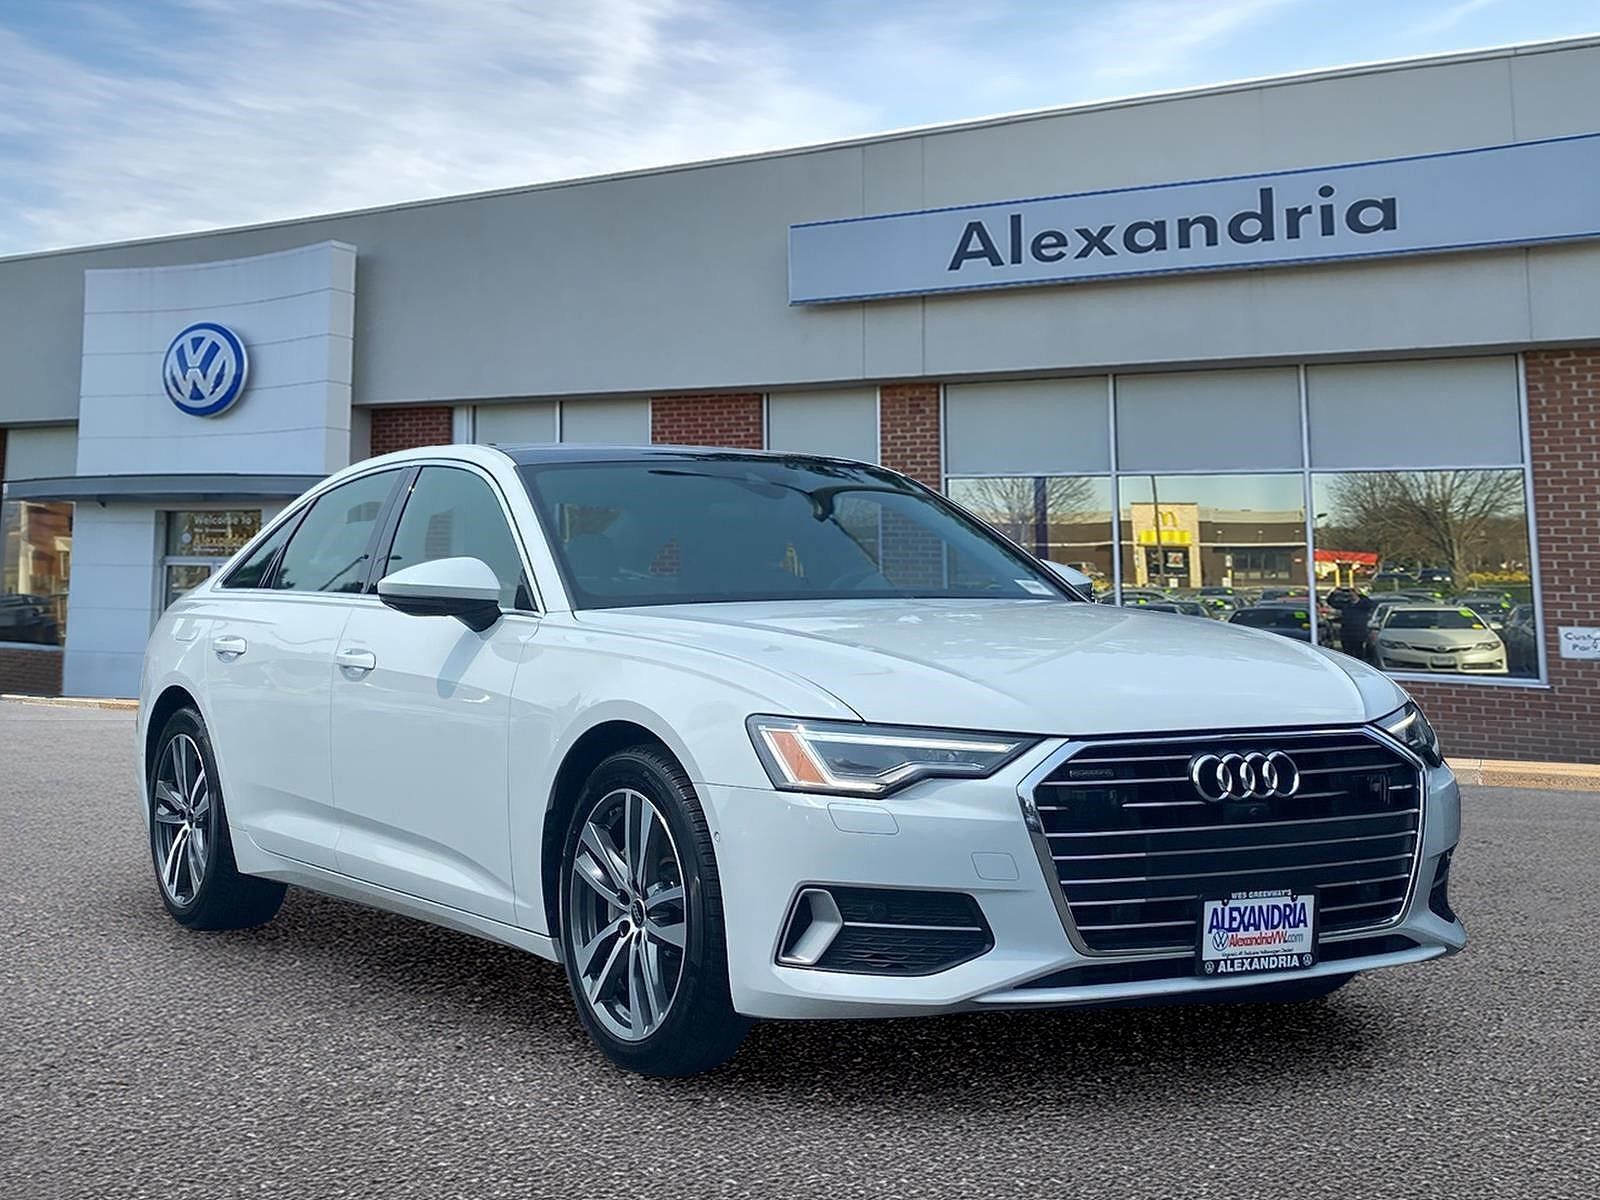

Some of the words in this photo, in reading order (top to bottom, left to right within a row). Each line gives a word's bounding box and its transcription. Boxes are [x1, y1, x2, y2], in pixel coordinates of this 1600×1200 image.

[948, 185, 1398, 271] Alexandria
[1207, 902, 1308, 934] ALEXANDRIA
[1217, 954, 1300, 973] ALEXANDRIA
